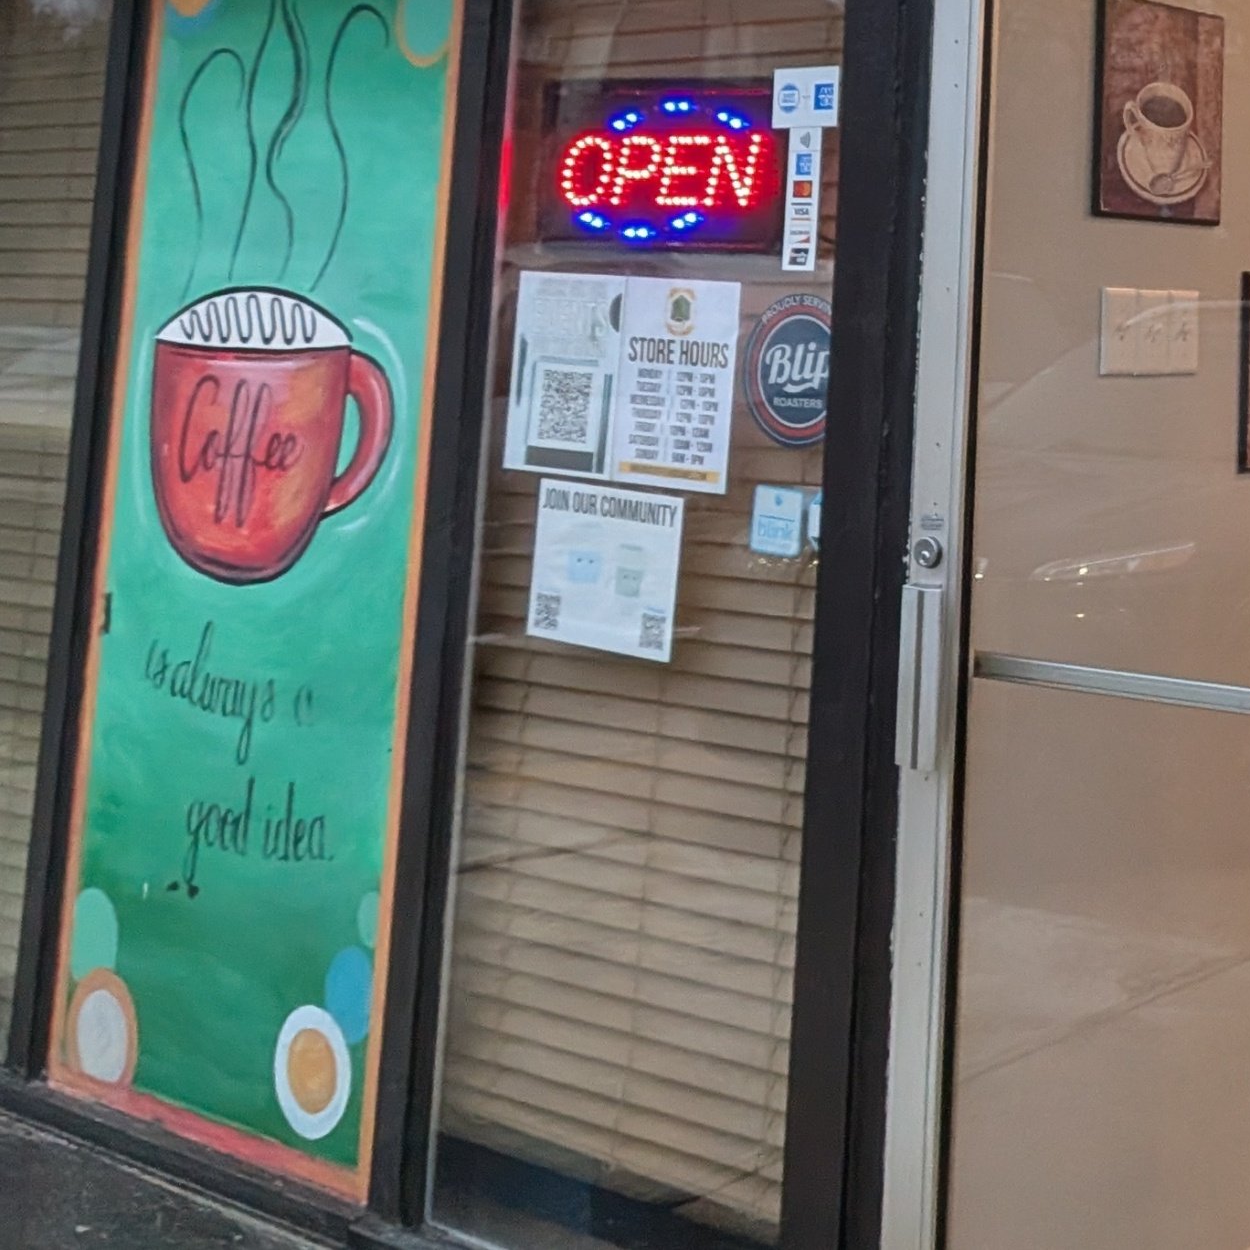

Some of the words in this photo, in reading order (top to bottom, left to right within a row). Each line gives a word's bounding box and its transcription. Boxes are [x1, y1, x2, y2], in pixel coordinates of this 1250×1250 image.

[561, 134, 763, 208] OPEN
[761, 295, 802, 324] PROUDLY
[803, 294, 832, 316] SERVIN
[628, 336, 676, 365] STORE
[678, 340, 729, 369] HOURS
[765, 341, 830, 393] Blip
[773, 396, 823, 409] ROASTERS
[178, 374, 301, 528] Coffee
[543, 487, 570, 511] JOIN
[572, 491, 597, 515] OUR
[600, 495, 678, 527] COMMUNITY
[183, 777, 255, 886] good
